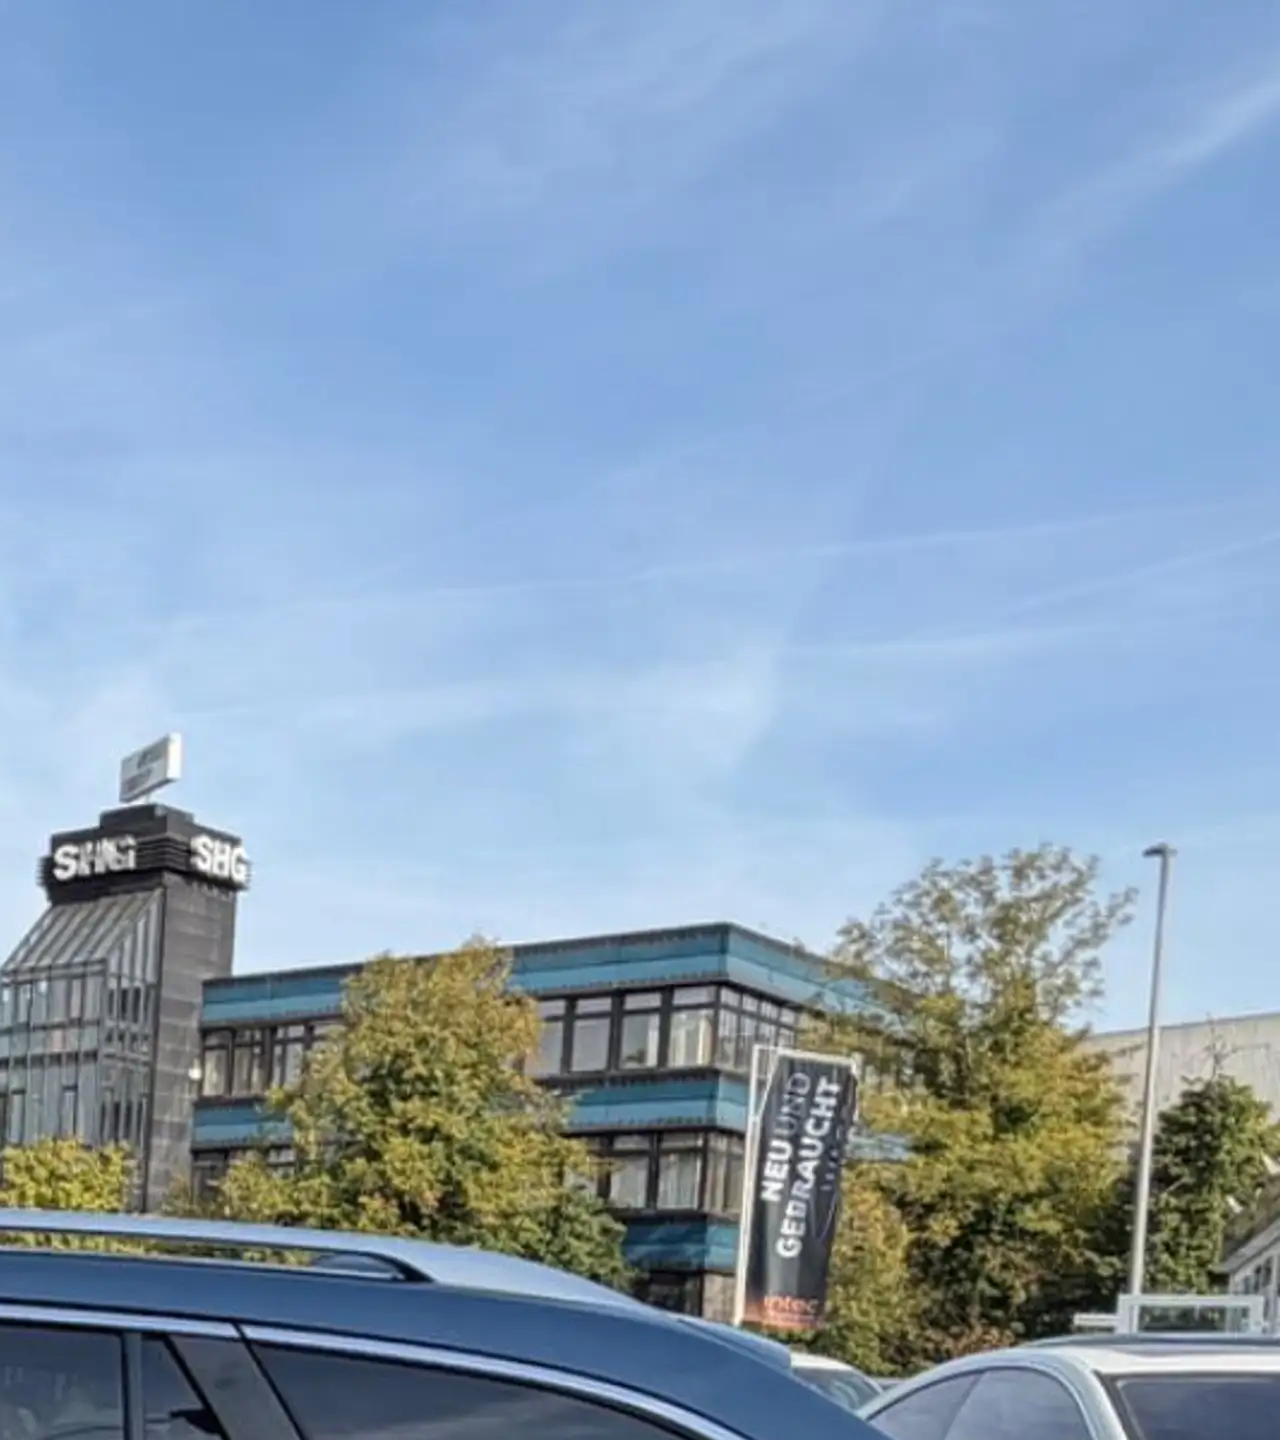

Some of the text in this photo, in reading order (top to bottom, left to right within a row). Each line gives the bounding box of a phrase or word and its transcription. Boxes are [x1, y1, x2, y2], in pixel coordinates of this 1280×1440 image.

[191, 835, 248, 882] SHG
[760, 1072, 811, 1201] NEU UND
[775, 1075, 840, 1258] GEBRAUCHT
